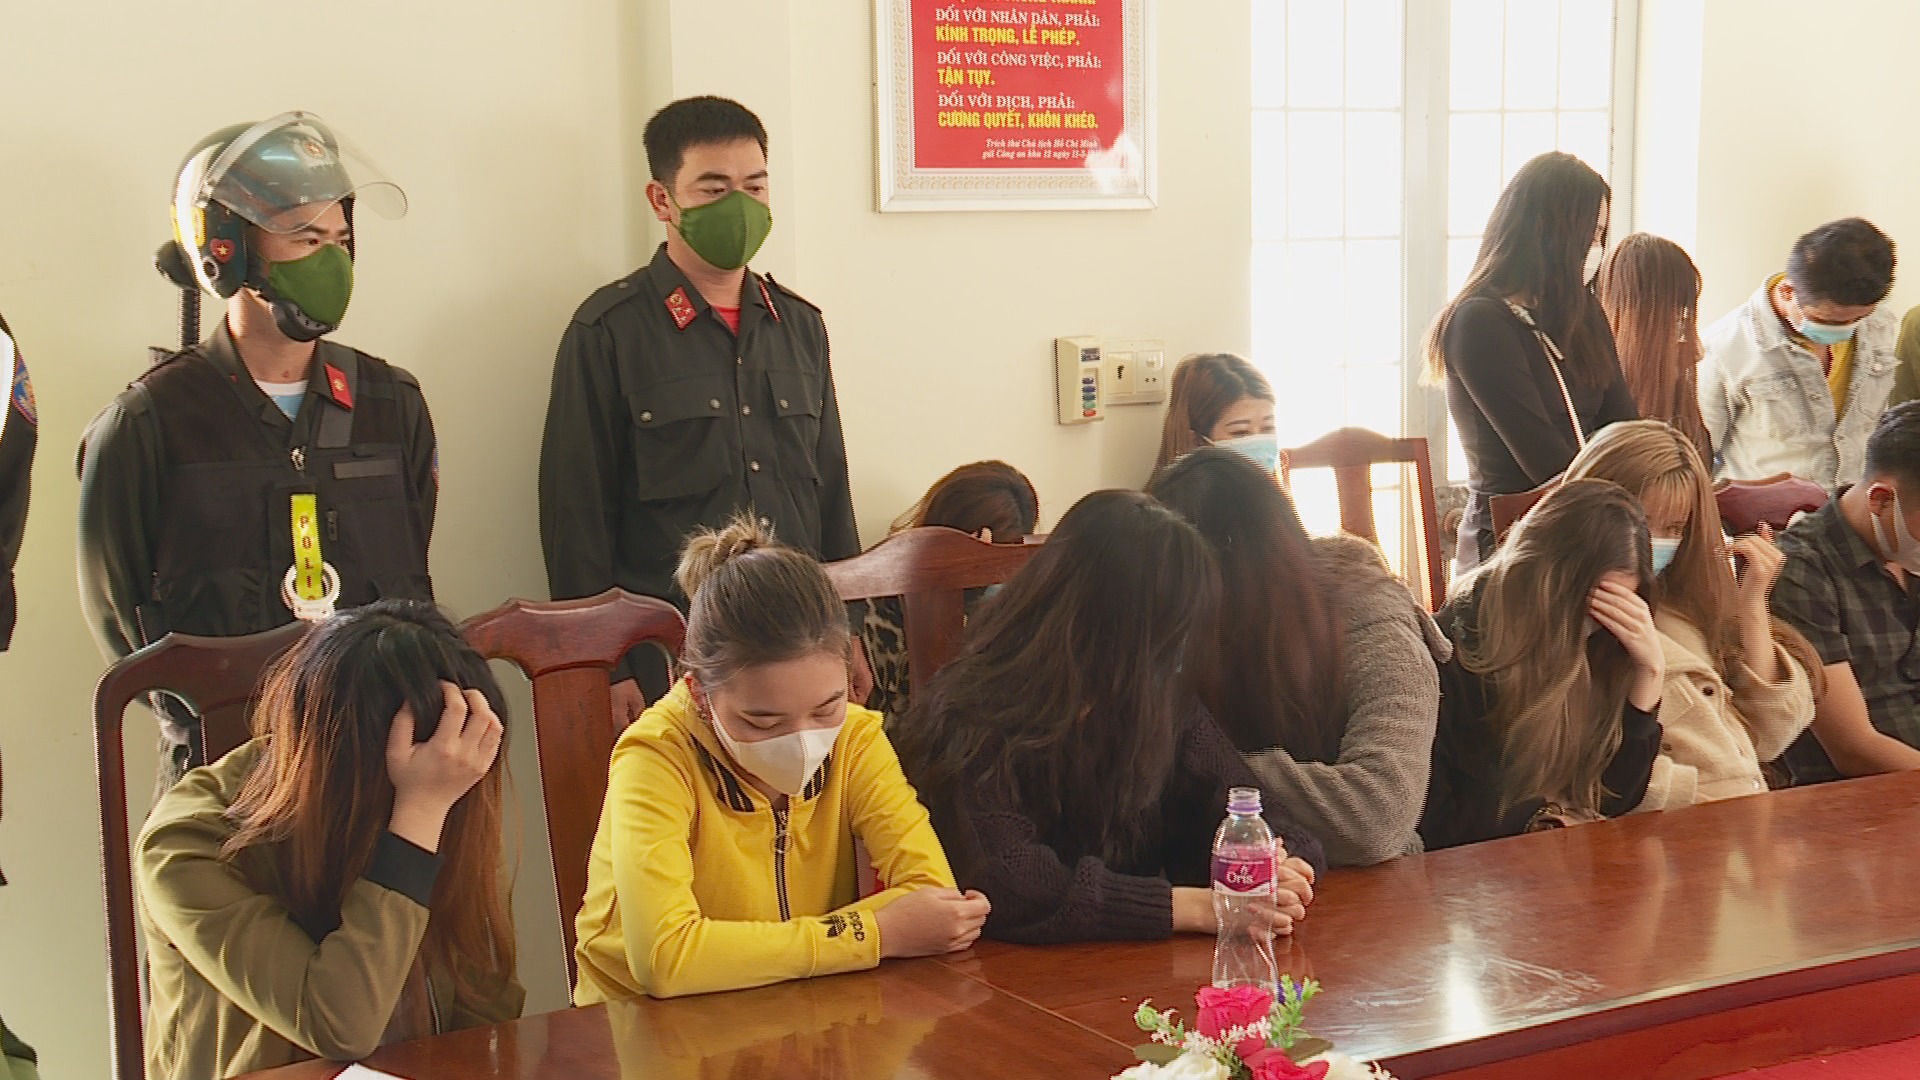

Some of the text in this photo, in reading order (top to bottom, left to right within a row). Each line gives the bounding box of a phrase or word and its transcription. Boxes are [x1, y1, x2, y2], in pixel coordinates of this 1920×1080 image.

[935, 4, 1100, 27] ĐỐI VỚI NHÂN DÂN, PHẢI:
[935, 22, 1080, 46] KÍNH TRỌNG, LỄ PHÉP.
[937, 47, 1102, 70] ĐỐI VỚI CÔNG VIỆC, PHẢI:
[937, 65, 996, 88] TẬN TỤY.
[938, 90, 1075, 110] ĐỐI VỚI ĐỊCH, PHẢI:
[938, 107, 1099, 129] CƯƠNG QUYẾT, KHÔN KHÉO.
[1226, 869, 1254, 885] Oris
